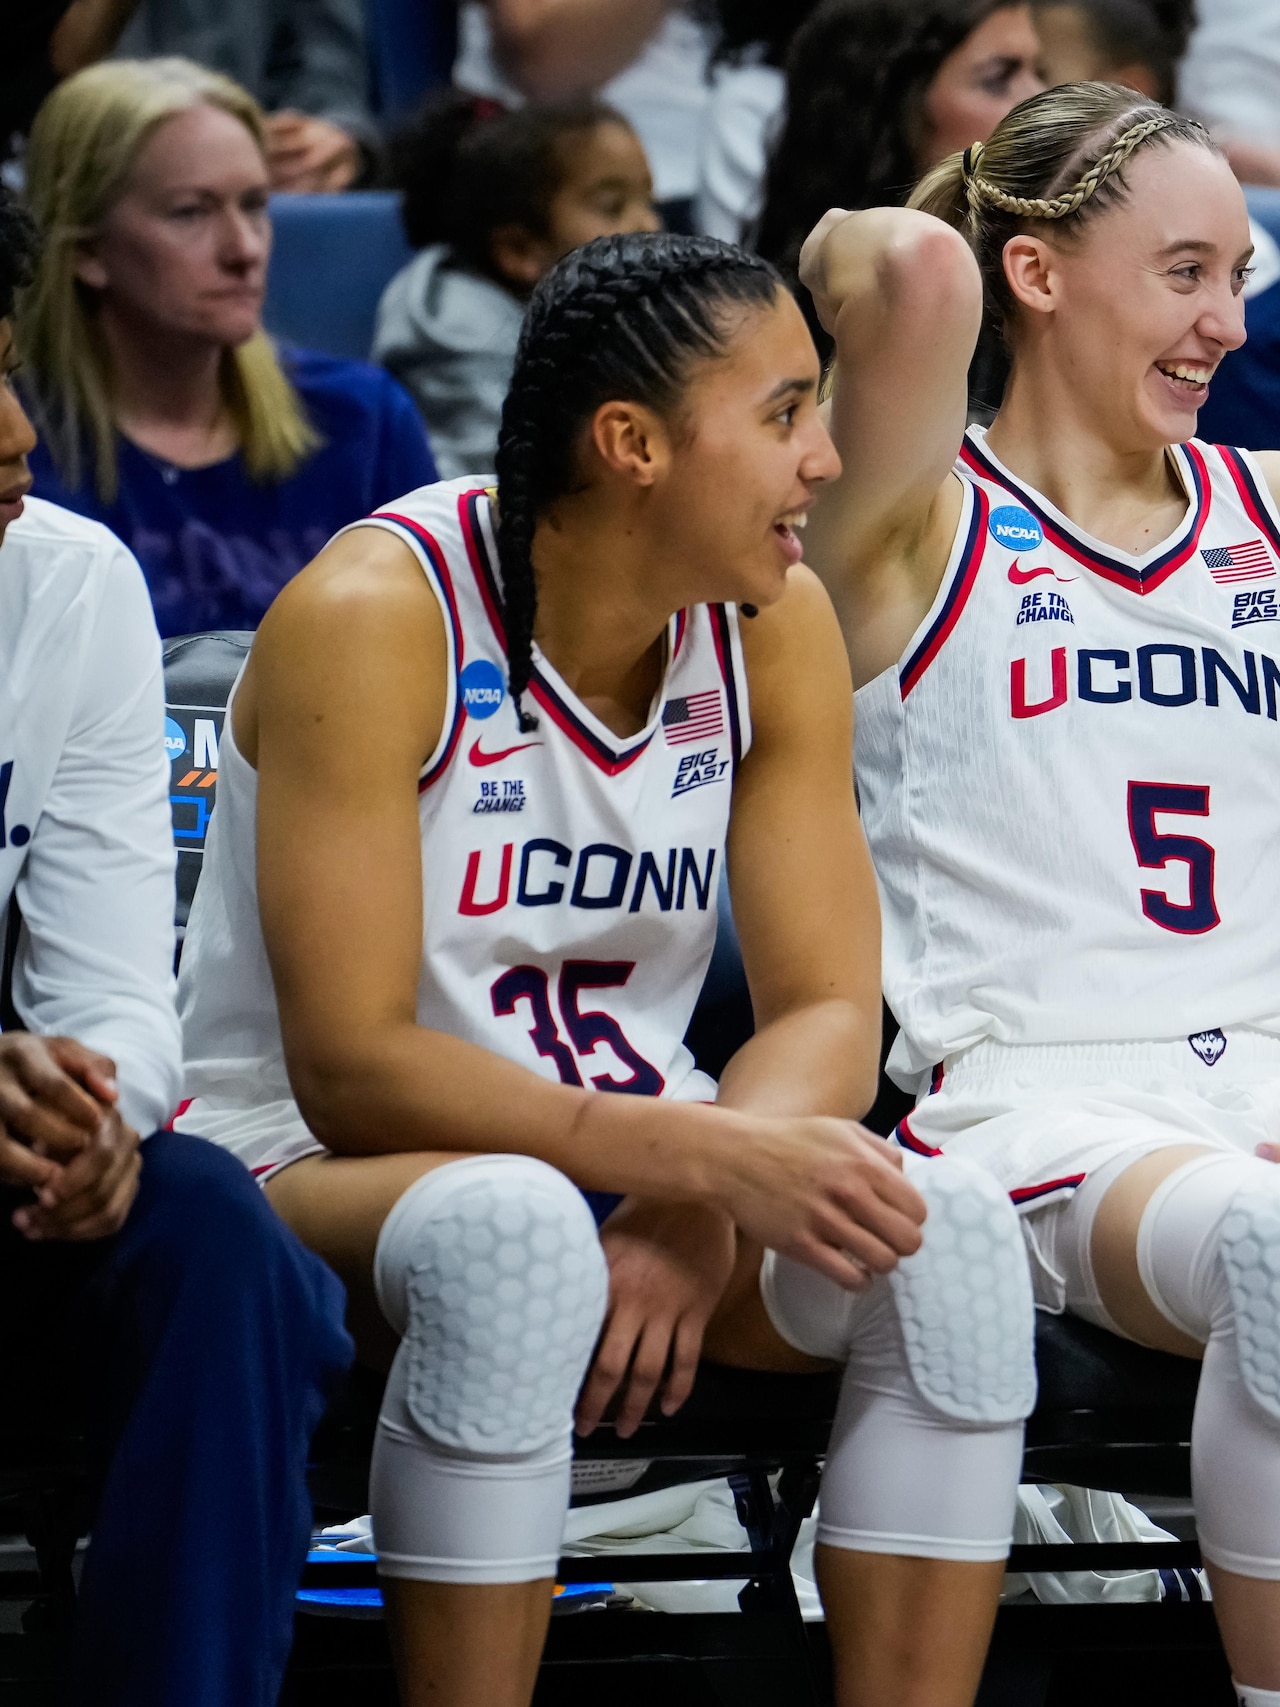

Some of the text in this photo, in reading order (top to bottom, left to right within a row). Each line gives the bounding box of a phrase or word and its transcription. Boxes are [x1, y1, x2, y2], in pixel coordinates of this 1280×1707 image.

[995, 523, 1041, 542] NCAA
[1020, 592, 1043, 610] BE
[1234, 589, 1276, 608] BIG
[463, 686, 501, 705] NCAA
[677, 747, 719, 774] BIG
[673, 760, 730, 790] EAST
[481, 780, 525, 798] BE THE
[473, 796, 527, 814] CHANGE
[1127, 780, 1221, 935] 5
[457, 838, 717, 917] UCONN
[490, 959, 666, 1098] 35
